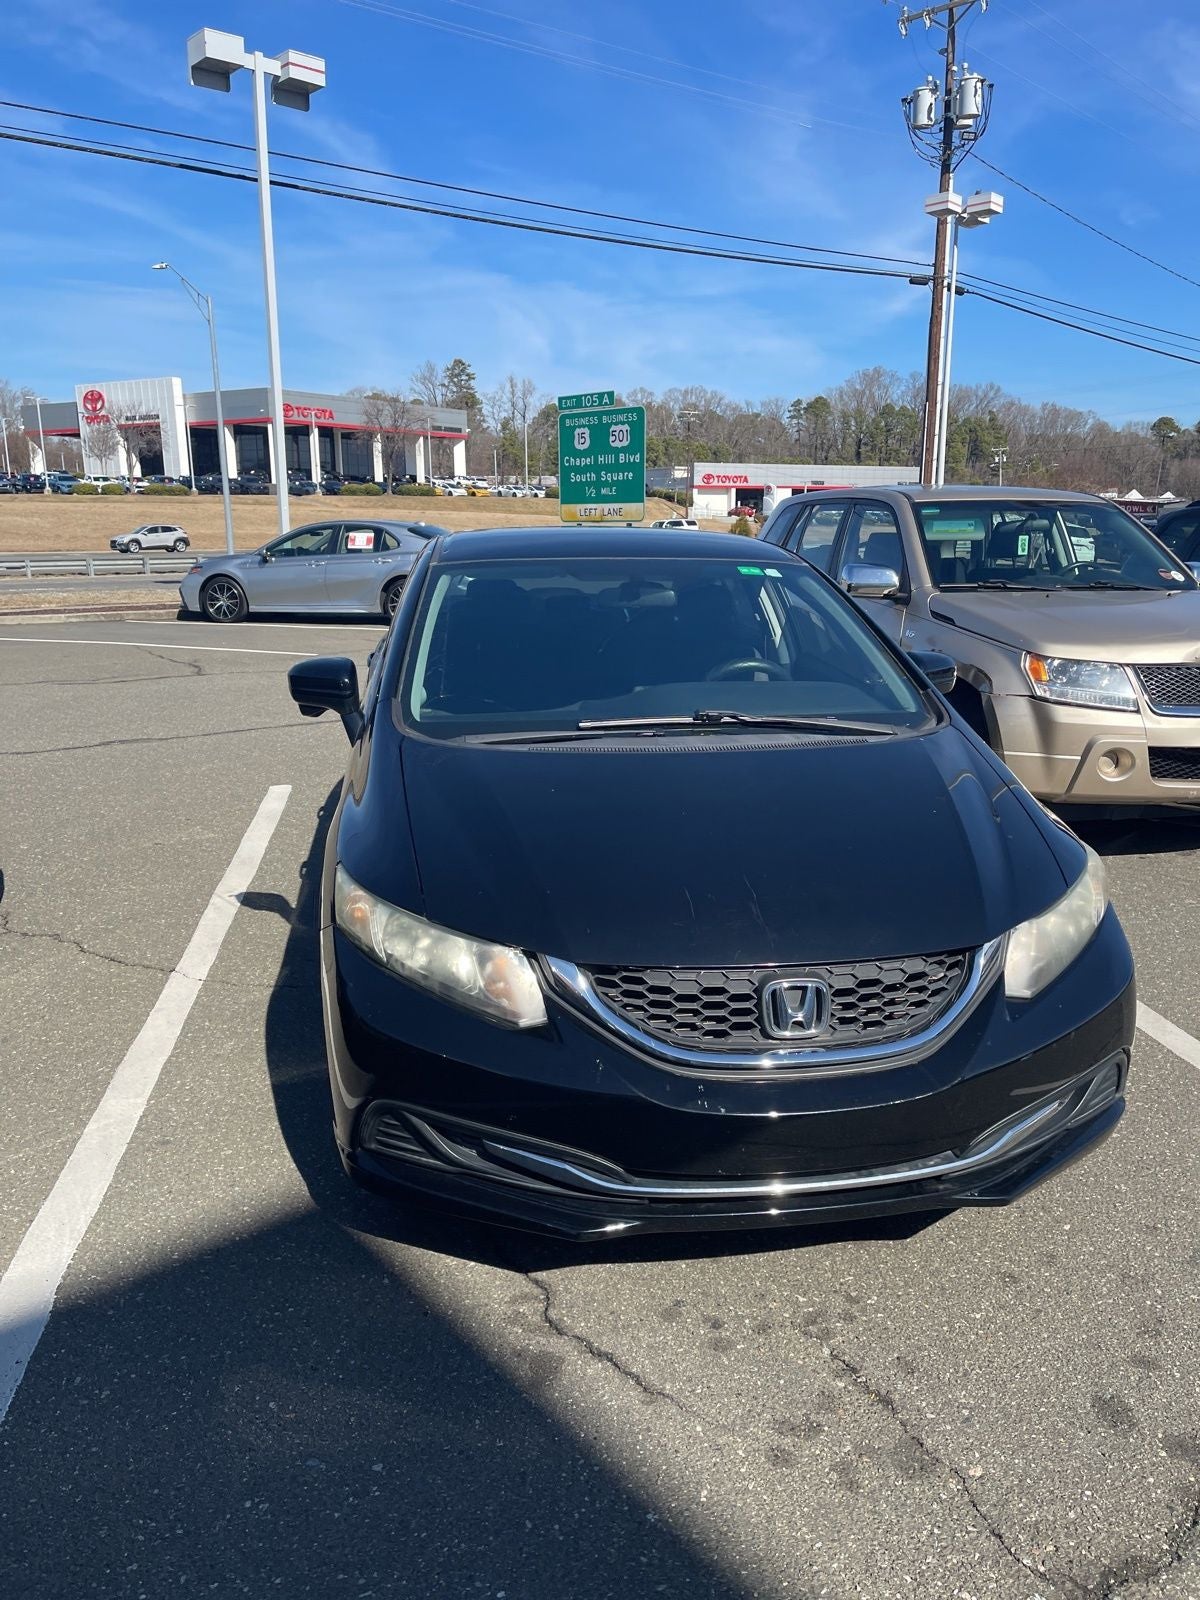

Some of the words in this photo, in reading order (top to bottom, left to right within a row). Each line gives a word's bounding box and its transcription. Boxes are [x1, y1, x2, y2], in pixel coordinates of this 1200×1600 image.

[562, 398, 577, 408] EXIT
[581, 394, 600, 407] 105
[602, 393, 610, 405] A
[295, 405, 335, 420] TOYOTA
[565, 416, 599, 427] BUSINESS
[602, 412, 638, 424] BUSINESS
[577, 432, 587, 446] 15
[611, 429, 629, 444] 501
[563, 455, 594, 468] Chapel
[598, 453, 615, 465] Hill
[619, 452, 641, 464] Blvd
[570, 472, 596, 482] South
[600, 470, 633, 483] Square
[715, 475, 749, 484] TOYOTA
[601, 486, 617, 495] MILE
[579, 507, 598, 517] LEFT
[602, 507, 624, 517] LANE
